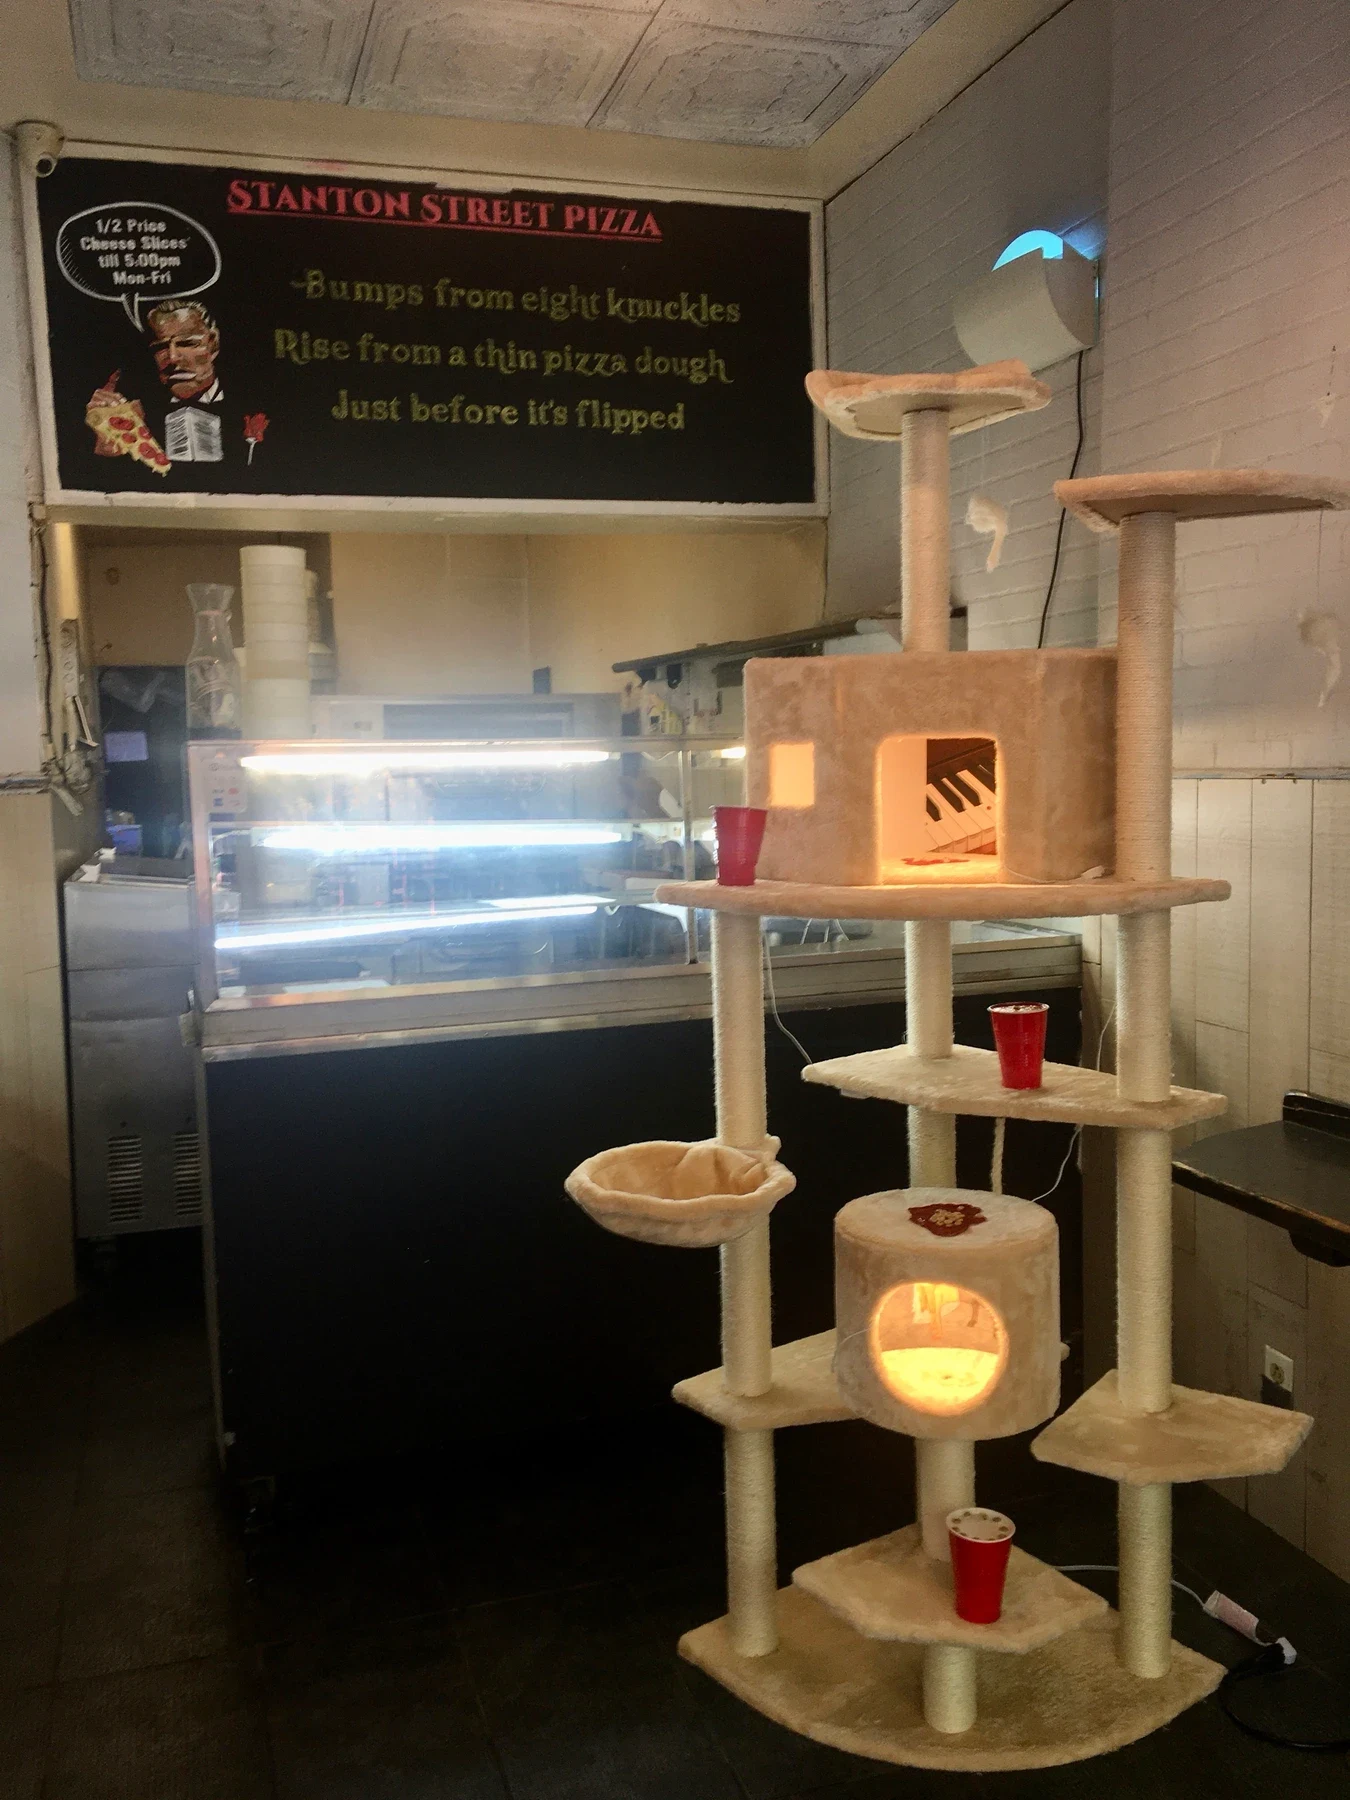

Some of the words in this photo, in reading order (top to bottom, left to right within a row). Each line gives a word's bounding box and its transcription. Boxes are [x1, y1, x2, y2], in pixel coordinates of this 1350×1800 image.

[227, 179, 411, 217] STANTON
[420, 192, 555, 231] STREET
[563, 203, 663, 238] PIZZA
[95, 218, 123, 234] 1/2
[127, 218, 167, 233] Price
[80, 235, 137, 251] Cheese
[140, 235, 188, 251] Slices
[98, 252, 120, 268] till
[112, 270, 172, 285] Mon-Fri
[432, 276, 515, 310] from
[522, 284, 601, 321] eight
[606, 287, 741, 328] knuckles
[274, 328, 350, 365] Rise
[356, 332, 442, 366] from
[448, 345, 468, 367] a
[473, 338, 537, 374] thin
[543, 344, 629, 377] pizza
[635, 347, 734, 384] dough
[331, 388, 401, 421] Just
[410, 392, 519, 426] before
[527, 397, 568, 427] it's
[576, 399, 685, 434] flipped
